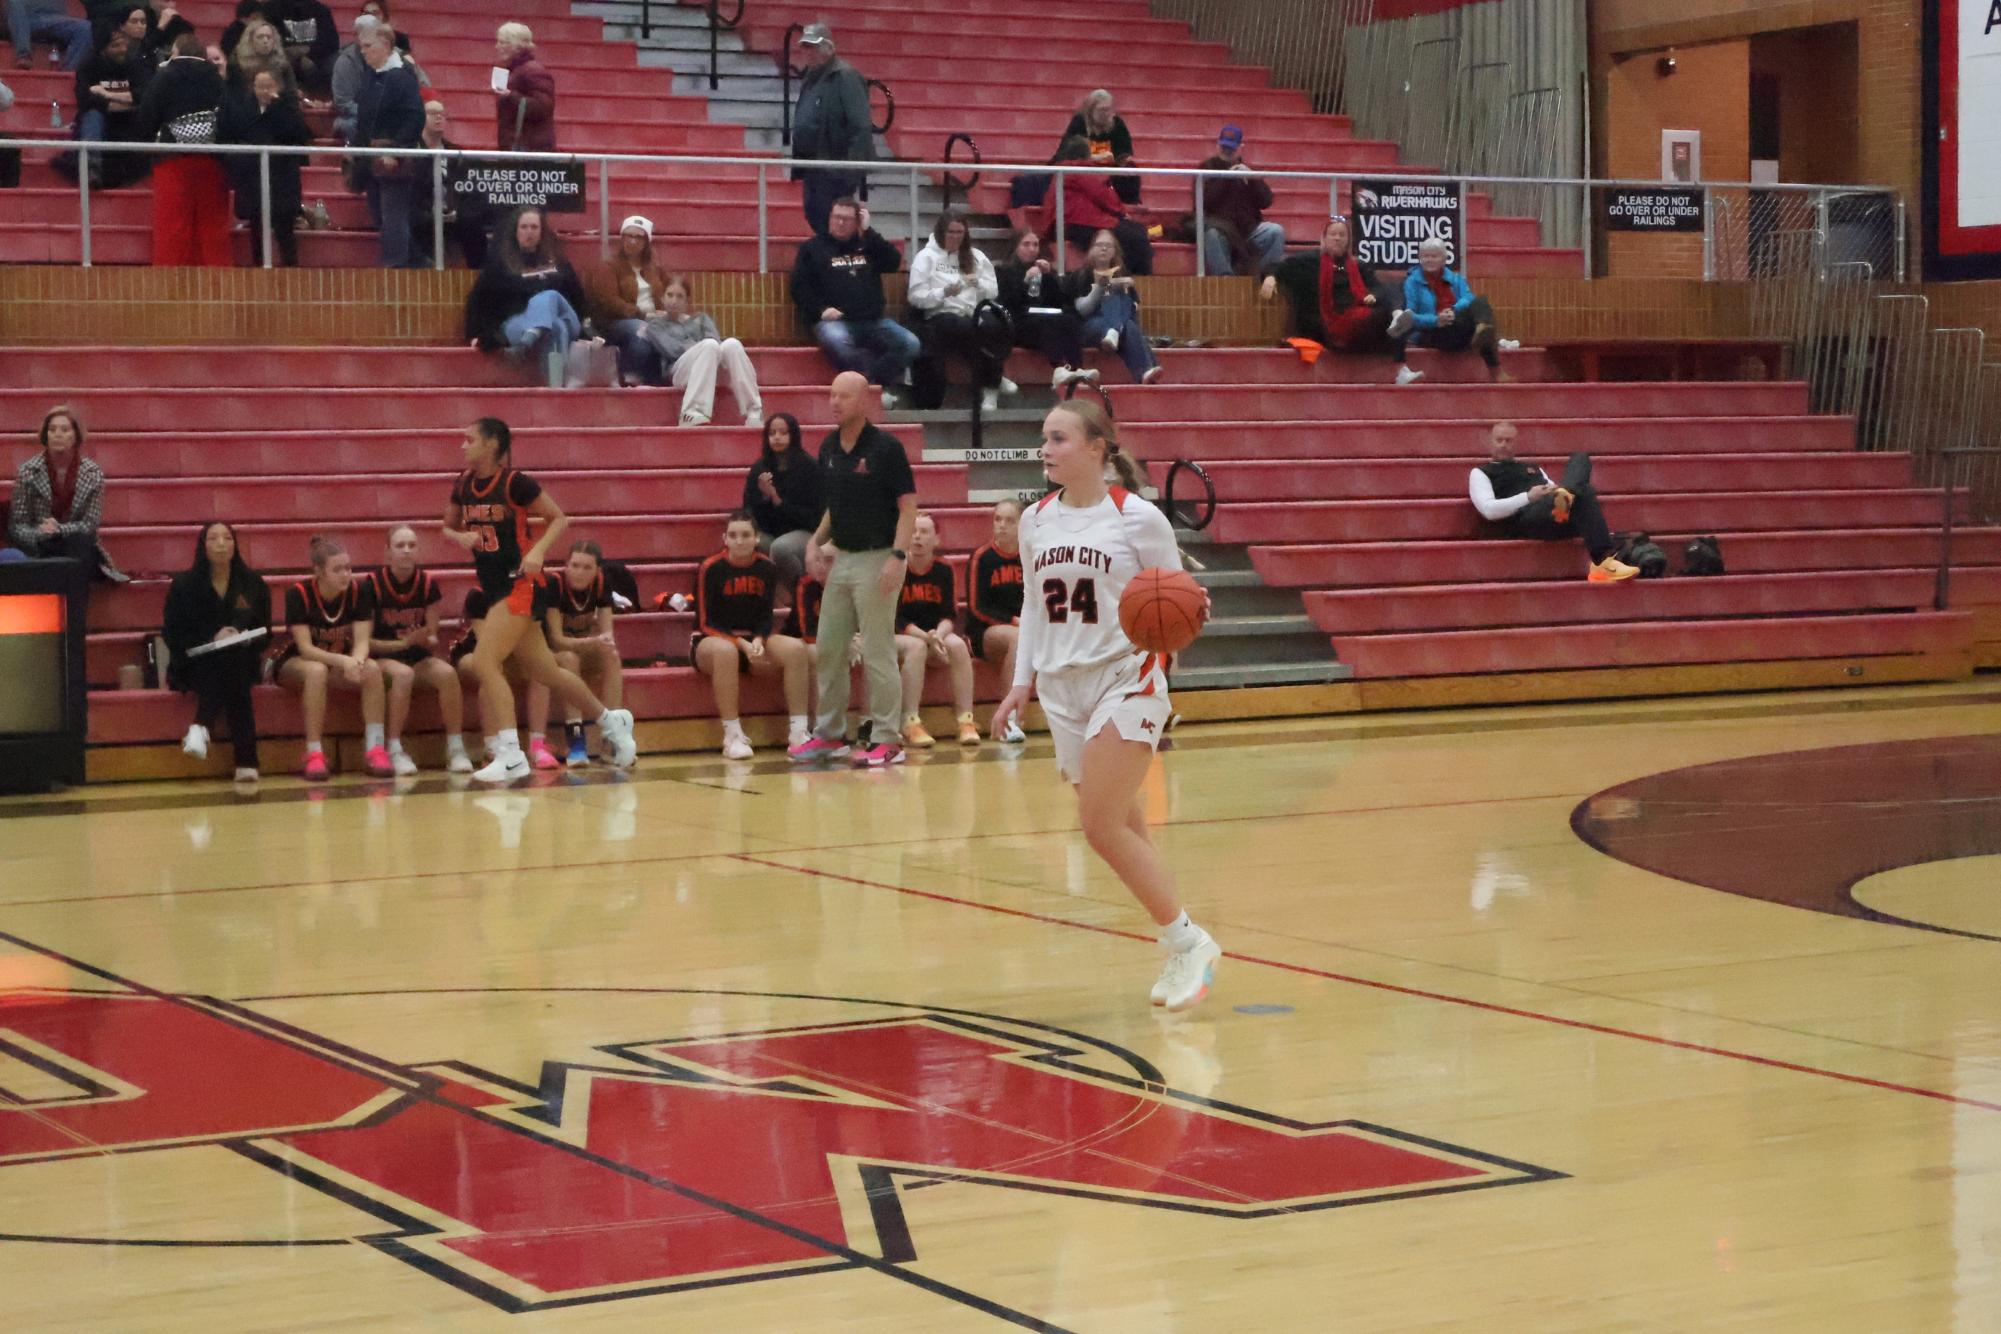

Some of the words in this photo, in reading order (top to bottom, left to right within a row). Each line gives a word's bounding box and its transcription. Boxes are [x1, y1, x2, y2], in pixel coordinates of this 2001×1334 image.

[467, 169, 517, 181] PLEASE
[520, 170, 538, 182] DO
[541, 171, 567, 182] NOT
[454, 181, 474, 192] GO
[477, 181, 512, 193] OVER
[515, 182, 534, 193] OR
[537, 183, 579, 194] UNDER
[1392, 185, 1425, 195] MASON
[1427, 186, 1446, 196] CITY
[488, 193, 547, 205] RAILINGS
[1381, 195, 1458, 209] RIVERHAWKS
[1618, 196, 1653, 205] PLEASE
[1655, 196, 1669, 206] DO
[1671, 197, 1690, 206] NOT
[1609, 206, 1623, 215] GO
[1625, 206, 1650, 215] OVER
[1652, 206, 1666, 216] OR
[1668, 206, 1699, 216] UNDER
[1633, 215, 1676, 225] RAILINGS
[1359, 214, 1453, 240] VISITING
[1358, 239, 1455, 265] STUDES
[965, 450, 978, 460] DO
[980, 450, 999, 460] NOT
[1001, 450, 1029, 459] CLIMB
[1018, 491, 1047, 501] CLOS
[1079, 546, 1112, 574] CITY
[990, 564, 1023, 586] AME
[723, 575, 766, 597] AMES
[1042, 577, 1099, 625] 24
